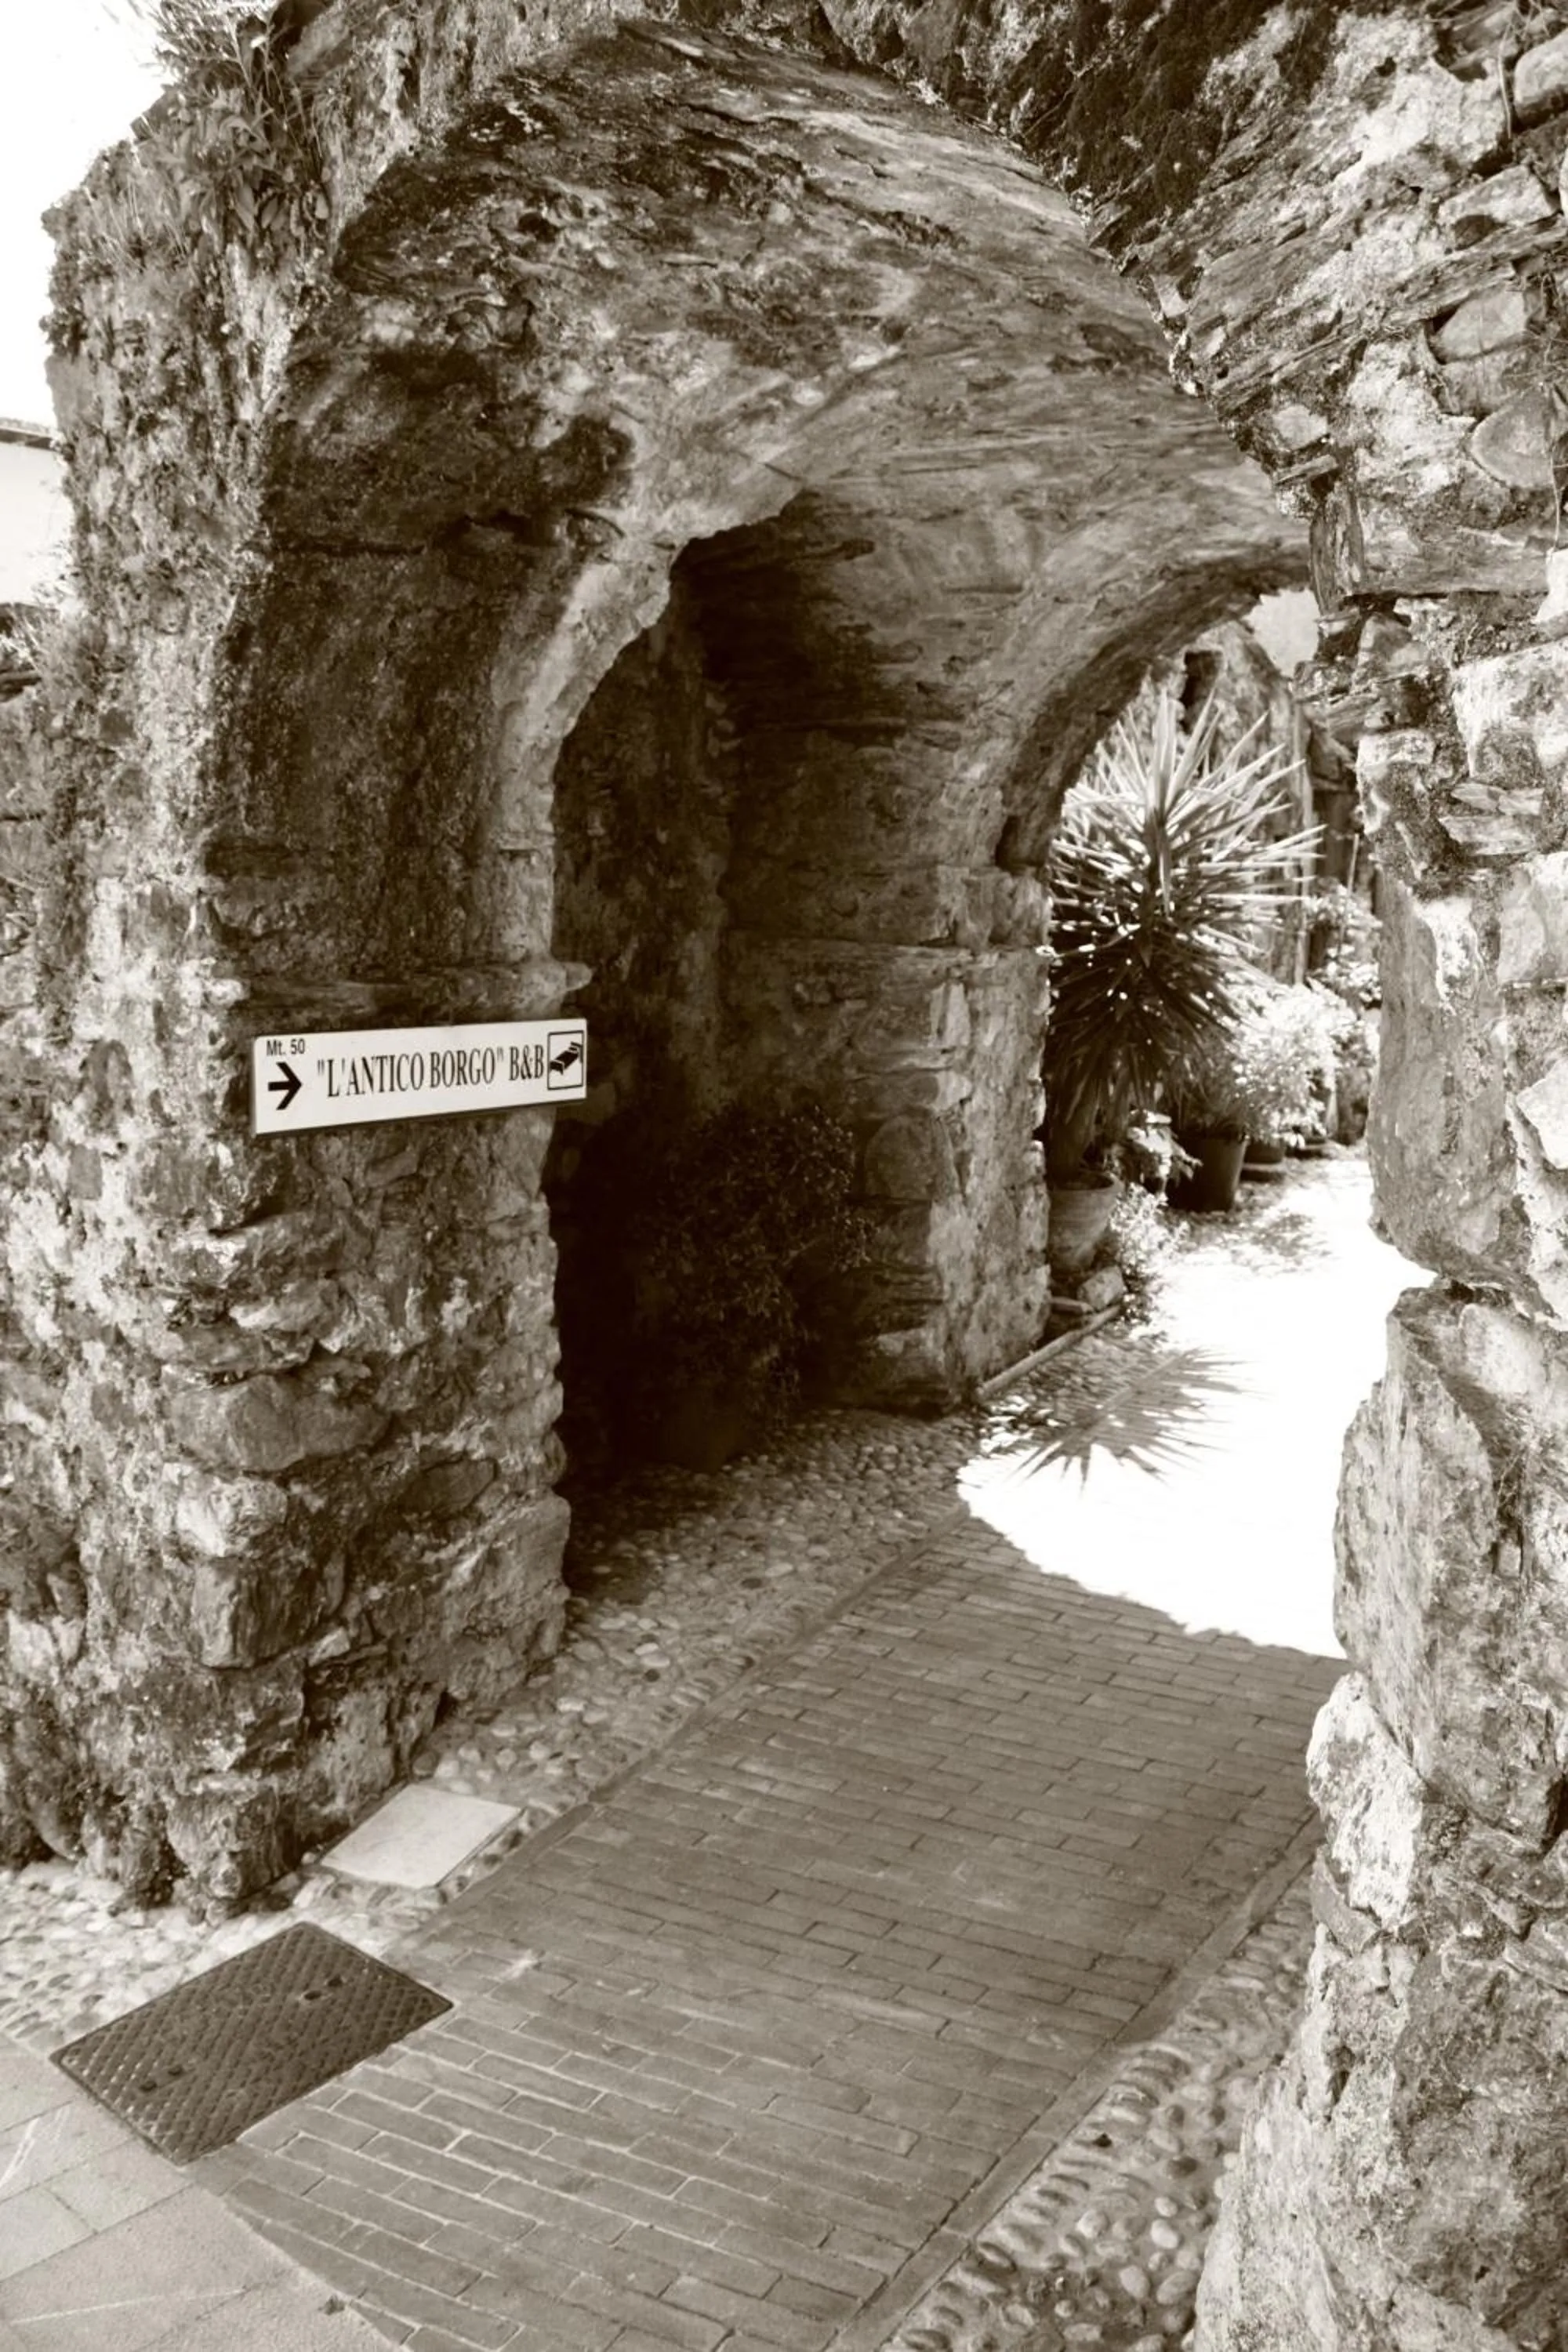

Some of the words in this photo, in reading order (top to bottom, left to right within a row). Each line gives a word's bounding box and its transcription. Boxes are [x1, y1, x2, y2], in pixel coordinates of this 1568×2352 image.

[267, 1040, 286, 1056] Mt.
[290, 1038, 306, 1054] 50
[317, 1052, 424, 1098] "L'ANTICO
[430, 1046, 504, 1088] BORGO"
[509, 1044, 544, 1081] B&B
